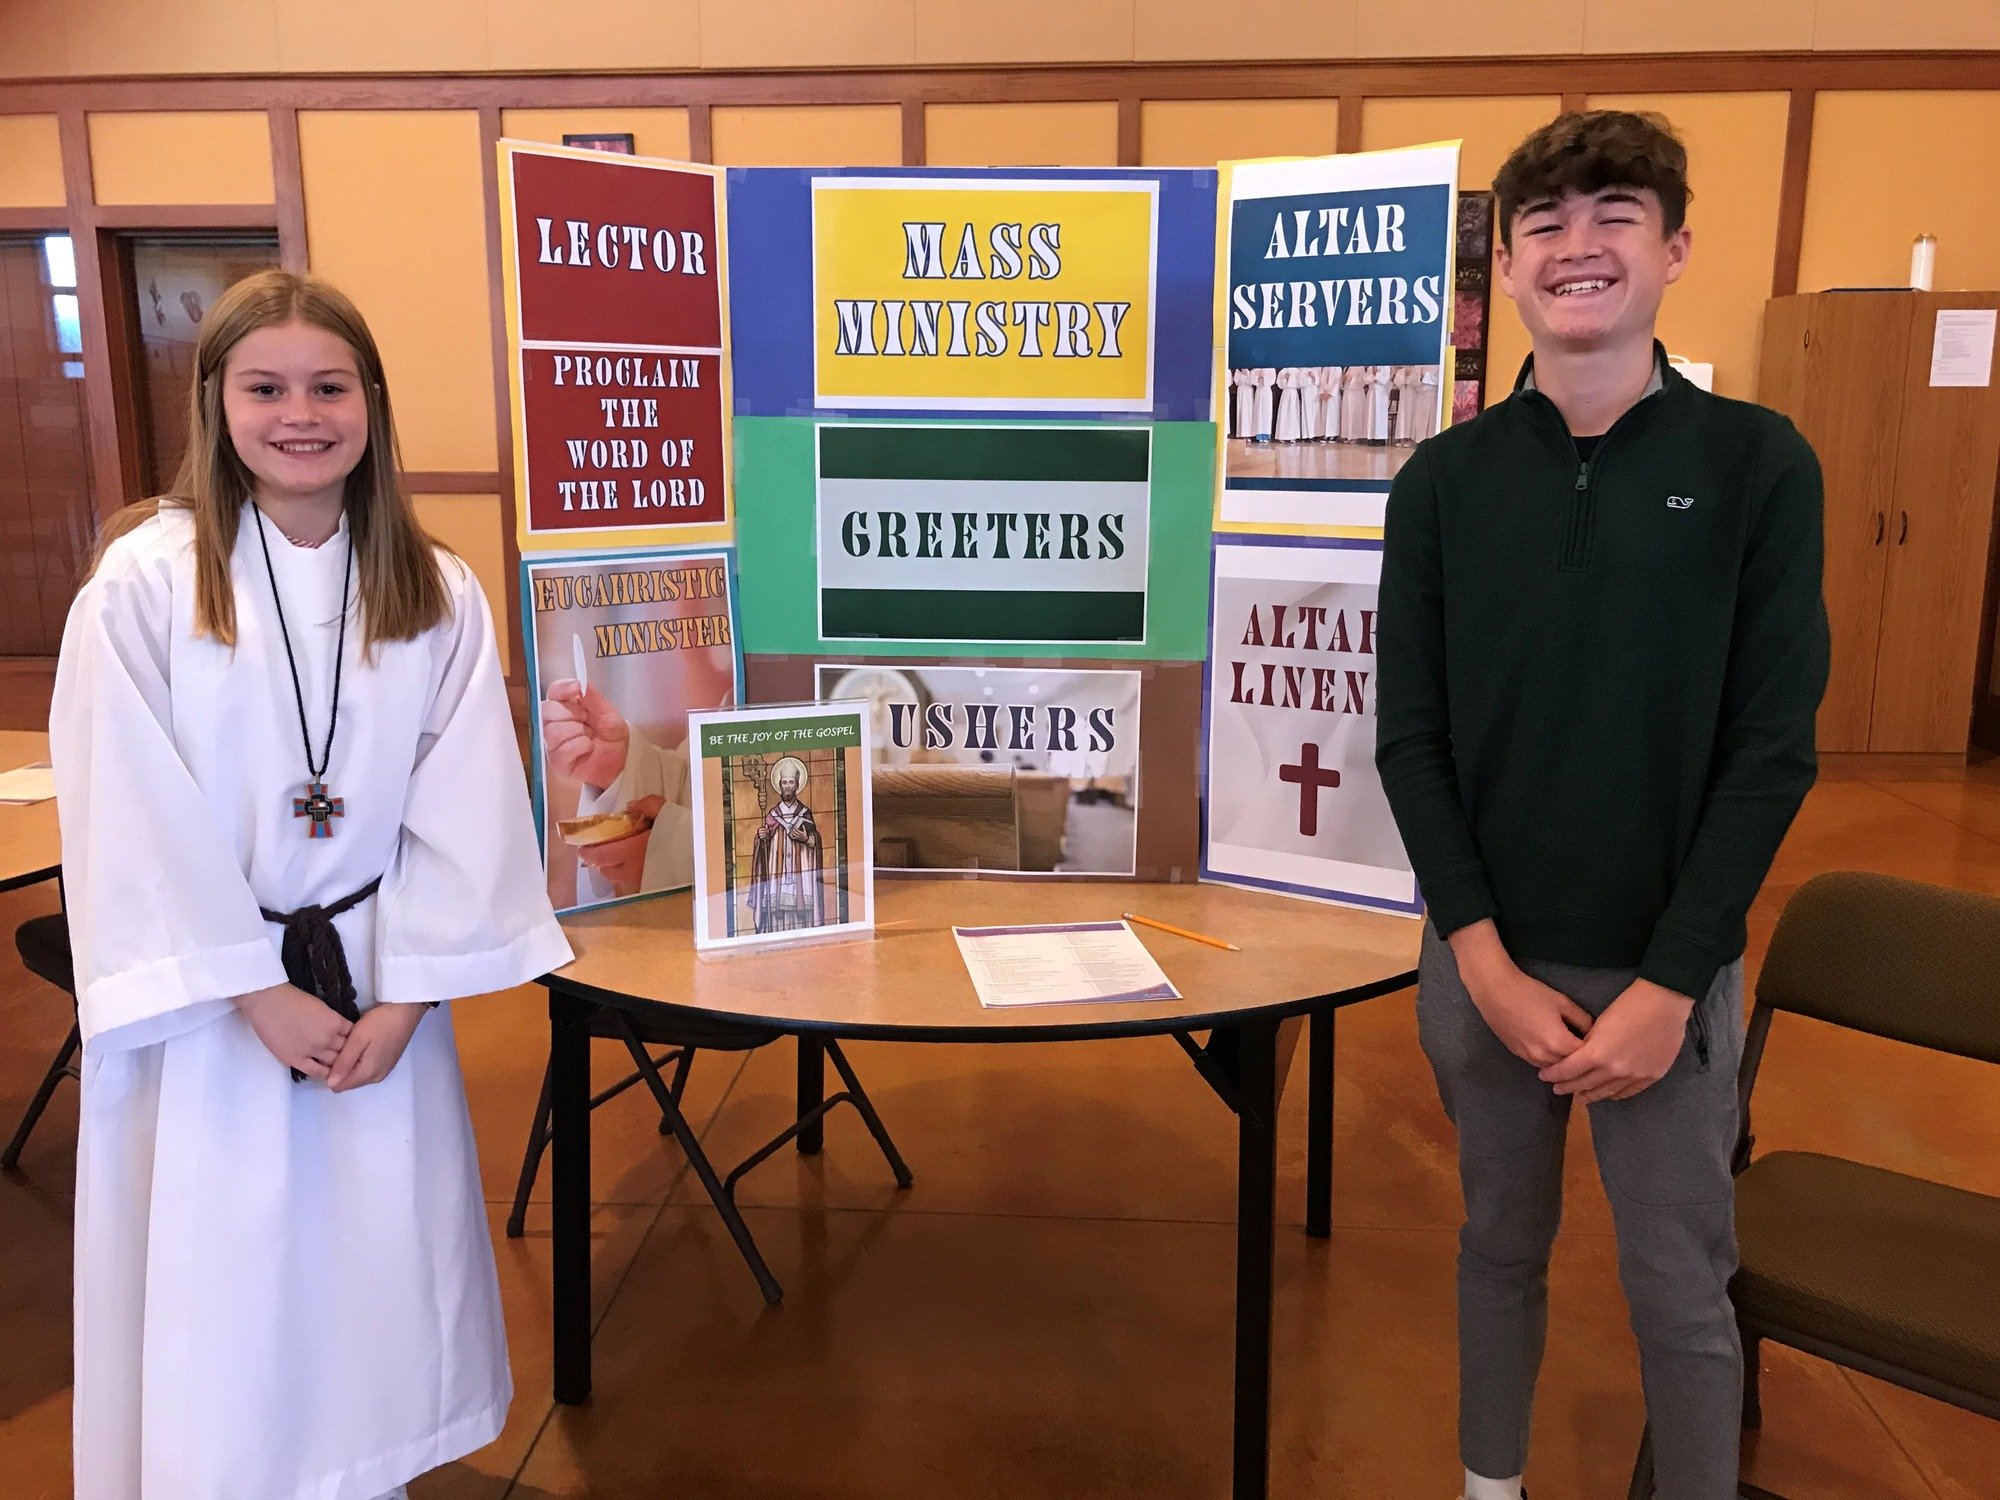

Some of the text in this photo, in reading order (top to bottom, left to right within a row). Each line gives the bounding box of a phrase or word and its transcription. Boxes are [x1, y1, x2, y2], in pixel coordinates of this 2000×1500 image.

[536, 217, 707, 275] LECTOR
[902, 222, 1061, 280] MASS
[1263, 204, 1407, 259] ALTAR
[1232, 275, 1440, 330] SERVERS
[834, 300, 1131, 357] MINISTRY
[553, 354, 700, 388] PROCLAIM
[600, 398, 659, 428] THE
[565, 439, 694, 469] WORD OF
[557, 478, 705, 511] THE LORD
[841, 510, 1125, 560] GREETERS
[533, 566, 725, 612] EUCAHRISTIC
[594, 615, 731, 658] MINISTER
[1230, 661, 1378, 716] LINEN
[709, 725, 855, 746] BE THE JOY OF THE GOSPEL
[888, 702, 1115, 752] USHERS
